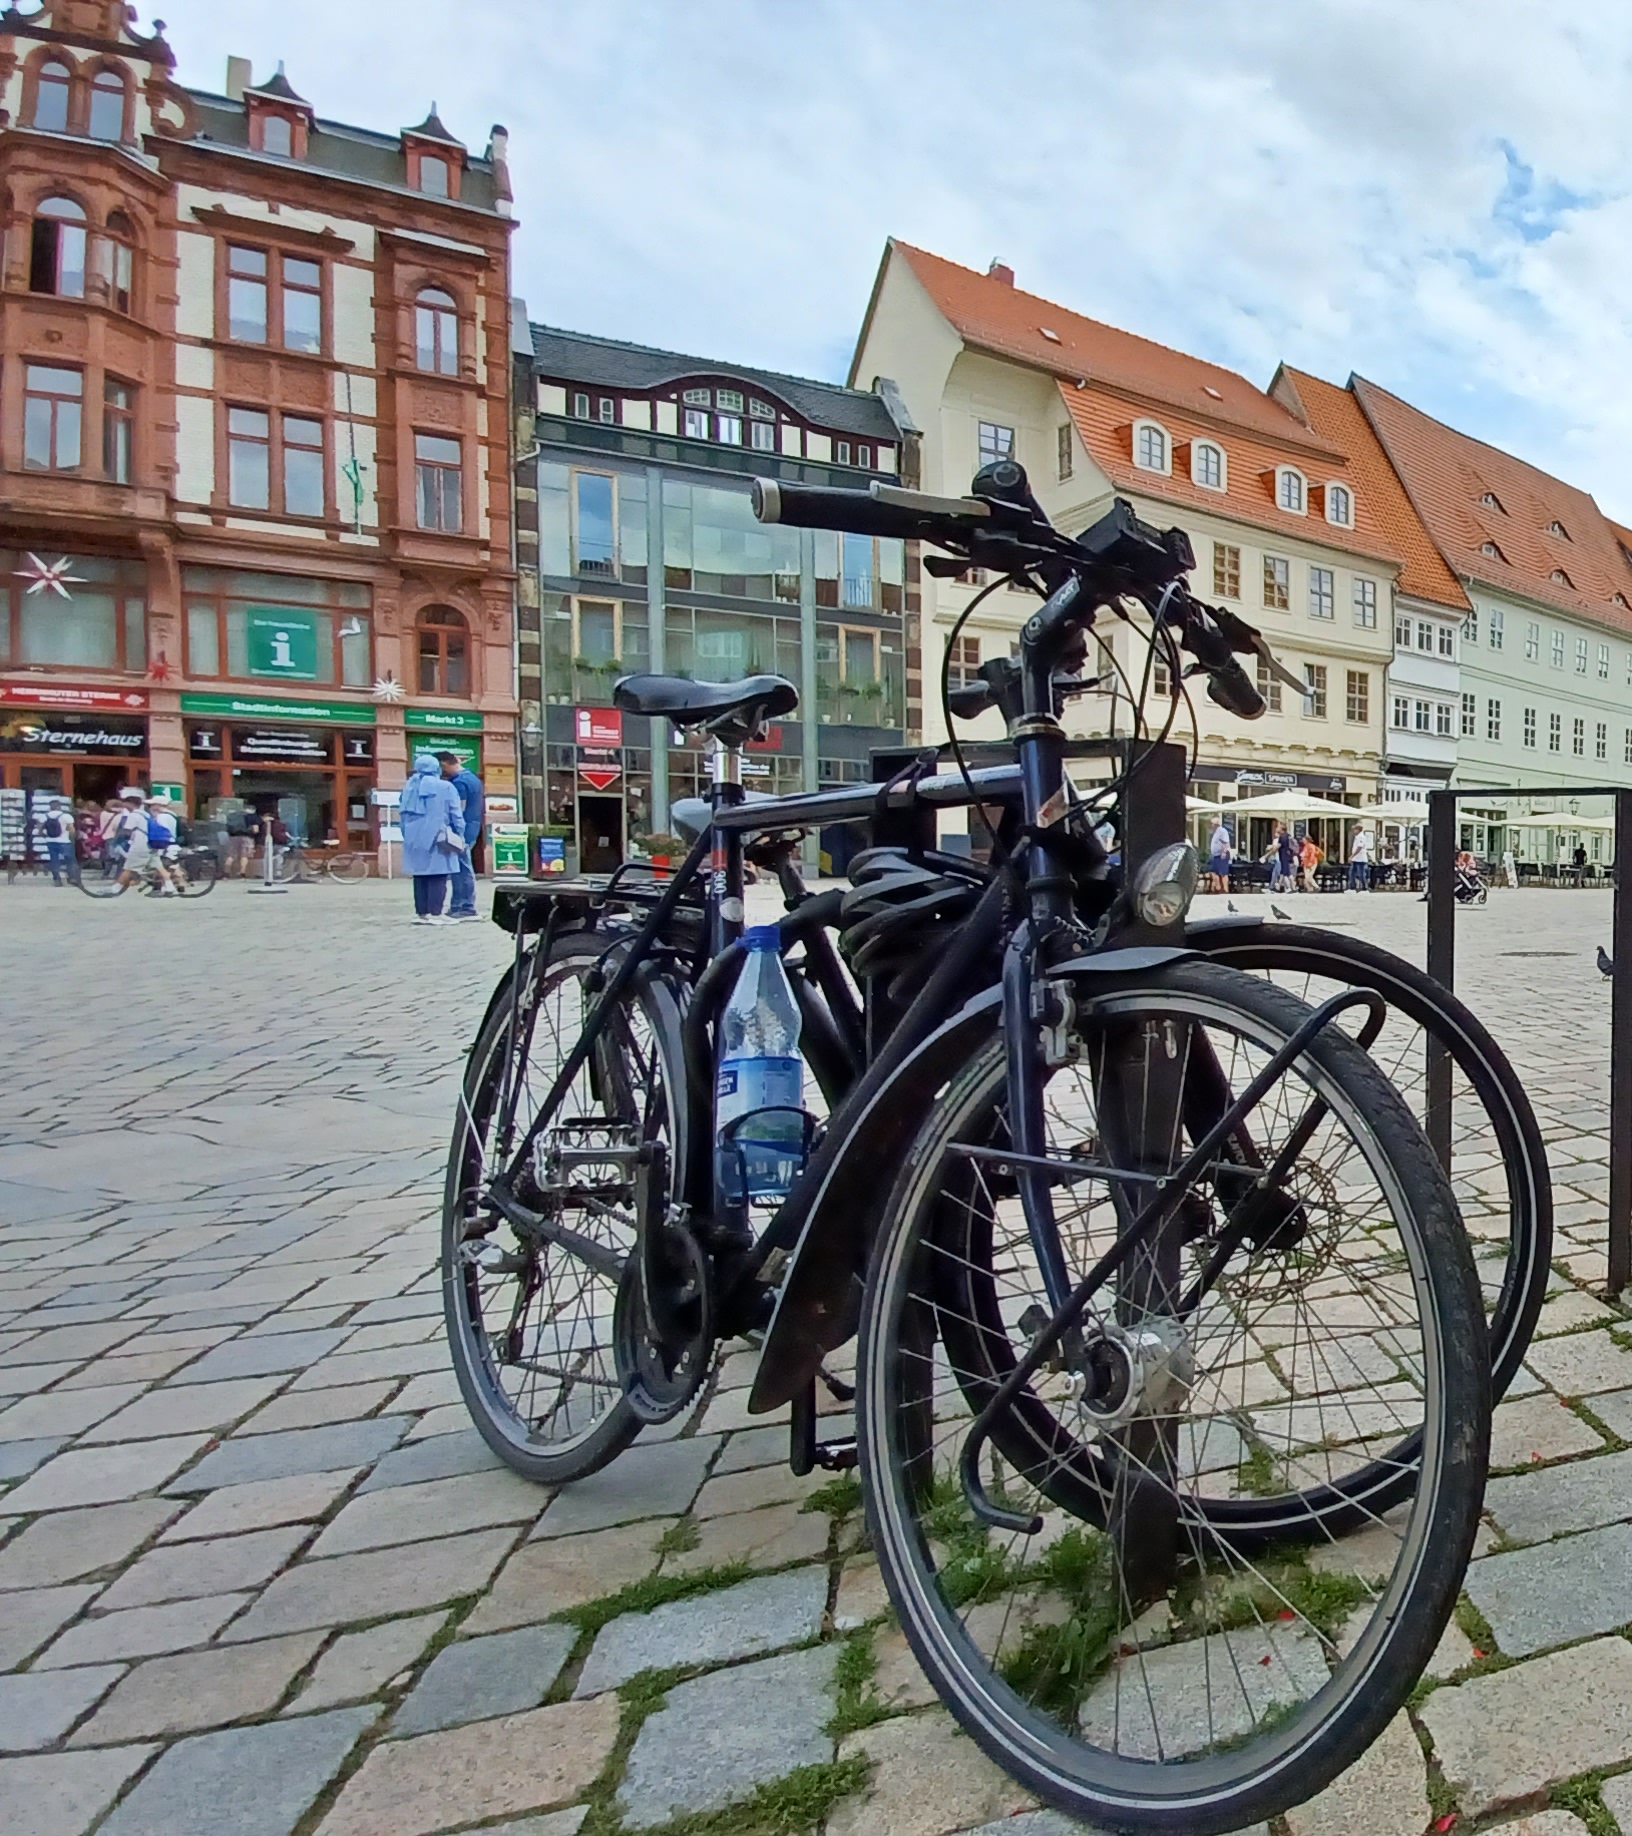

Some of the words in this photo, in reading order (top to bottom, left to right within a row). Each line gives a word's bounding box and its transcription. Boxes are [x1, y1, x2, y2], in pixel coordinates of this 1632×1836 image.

[232, 701, 331, 716] Stadtinformation
[425, 714, 456, 724] Markt
[457, 716, 464, 725] 3
[23, 728, 144, 747] Sternehaus
